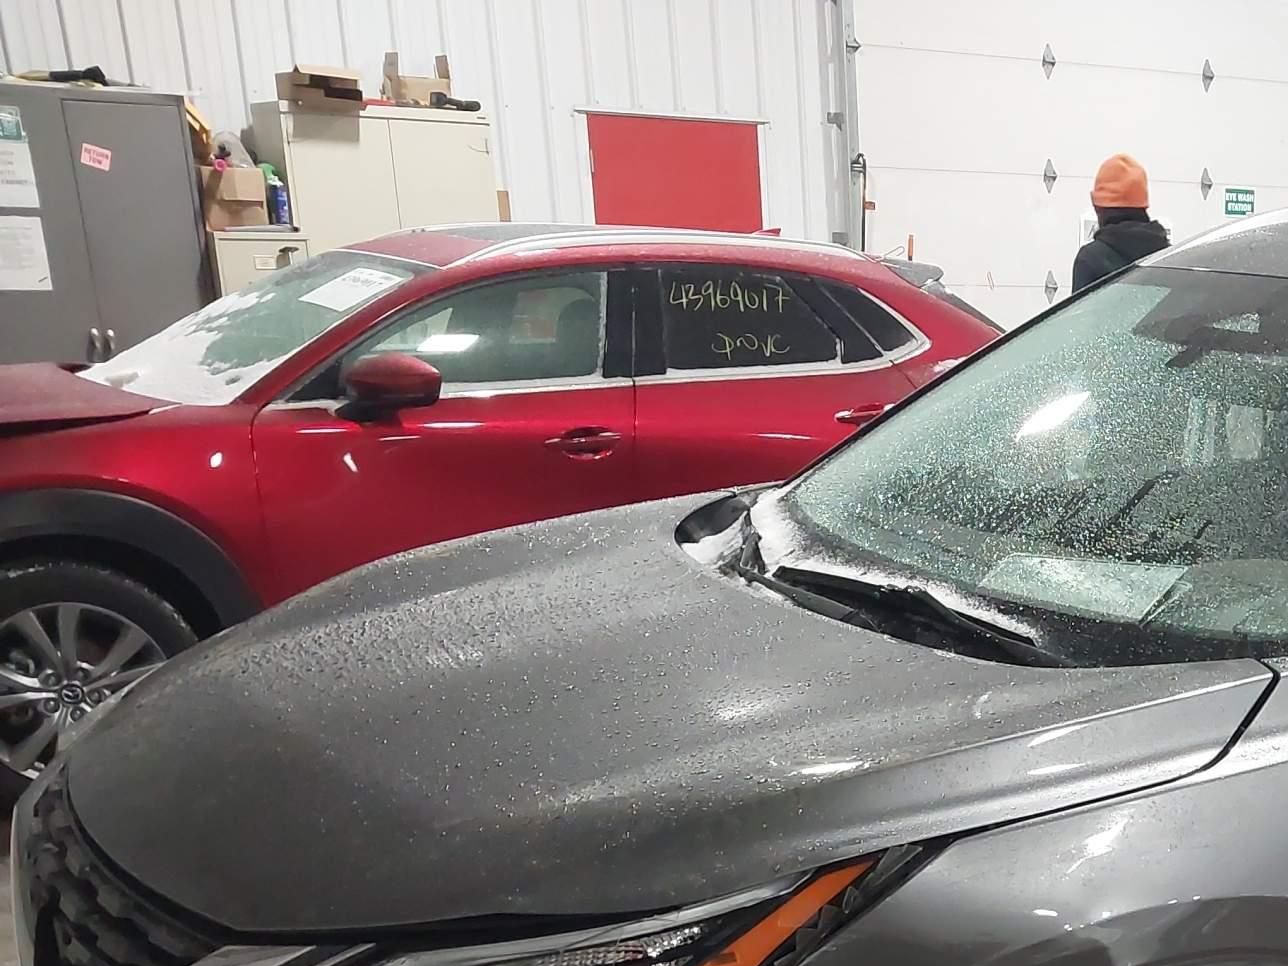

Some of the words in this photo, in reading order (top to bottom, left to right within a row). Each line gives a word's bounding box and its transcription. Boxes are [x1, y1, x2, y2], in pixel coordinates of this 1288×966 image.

[1225, 192, 1237, 201] EYE
[1237, 193, 1254, 202] WASH
[1227, 202, 1252, 212] STATION
[669, 279, 791, 313] 43969017
